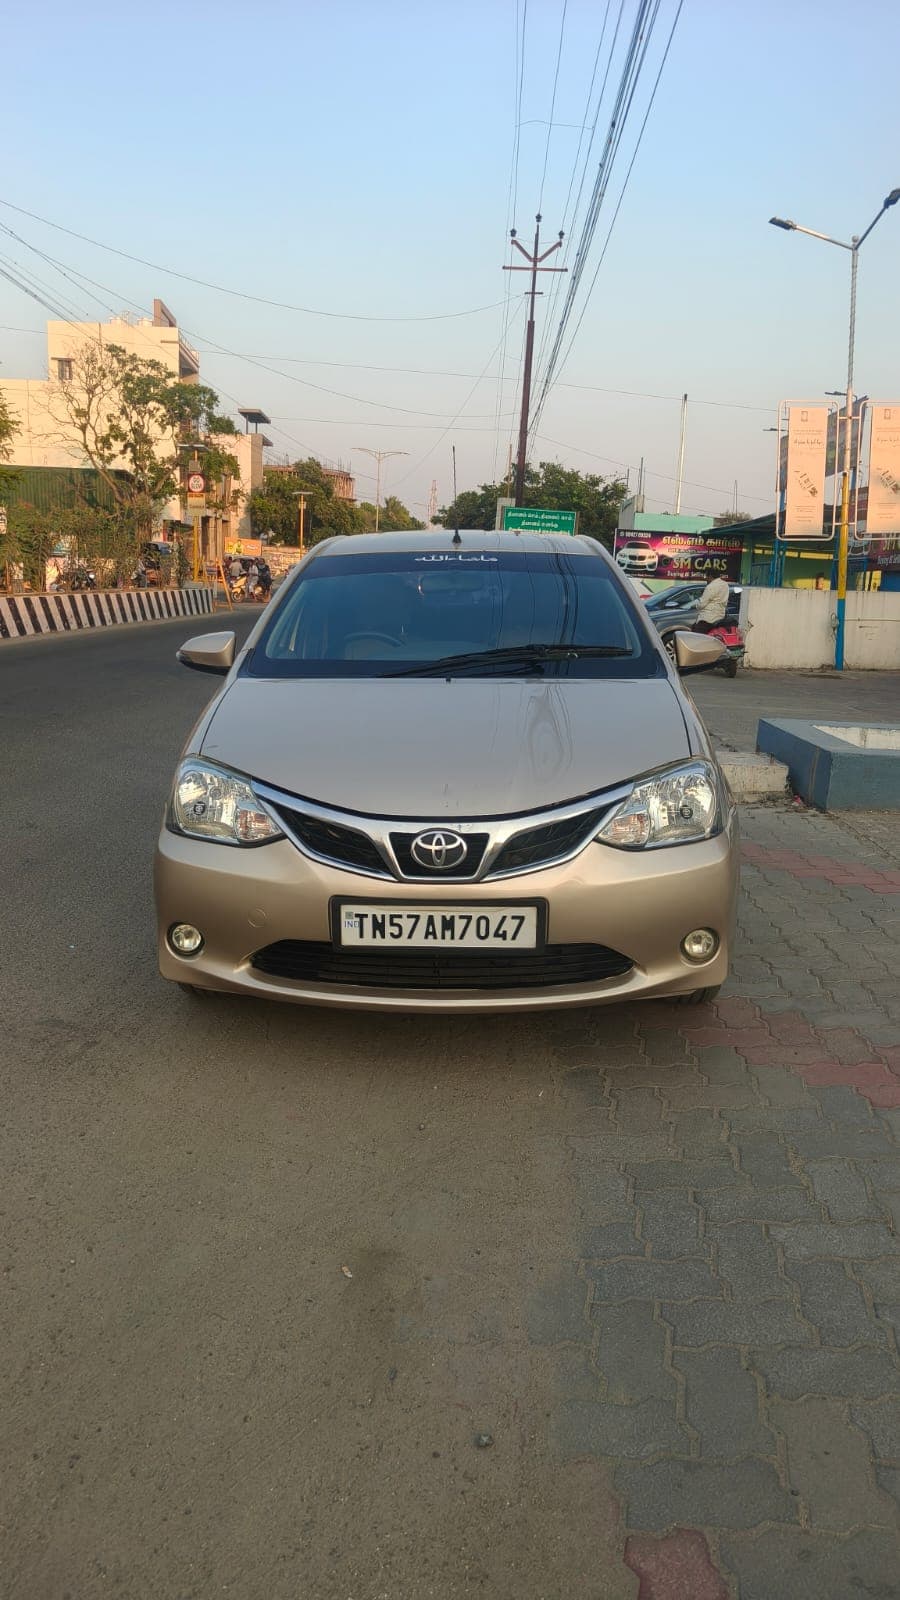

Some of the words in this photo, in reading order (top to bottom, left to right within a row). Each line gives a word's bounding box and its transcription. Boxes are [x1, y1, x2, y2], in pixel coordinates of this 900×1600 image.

[673, 559, 691, 569] SM
[695, 559, 727, 571] CARS
[691, 571, 707, 579] Selling
[344, 920, 359, 929] IND
[354, 913, 525, 941] TN57AM7047
